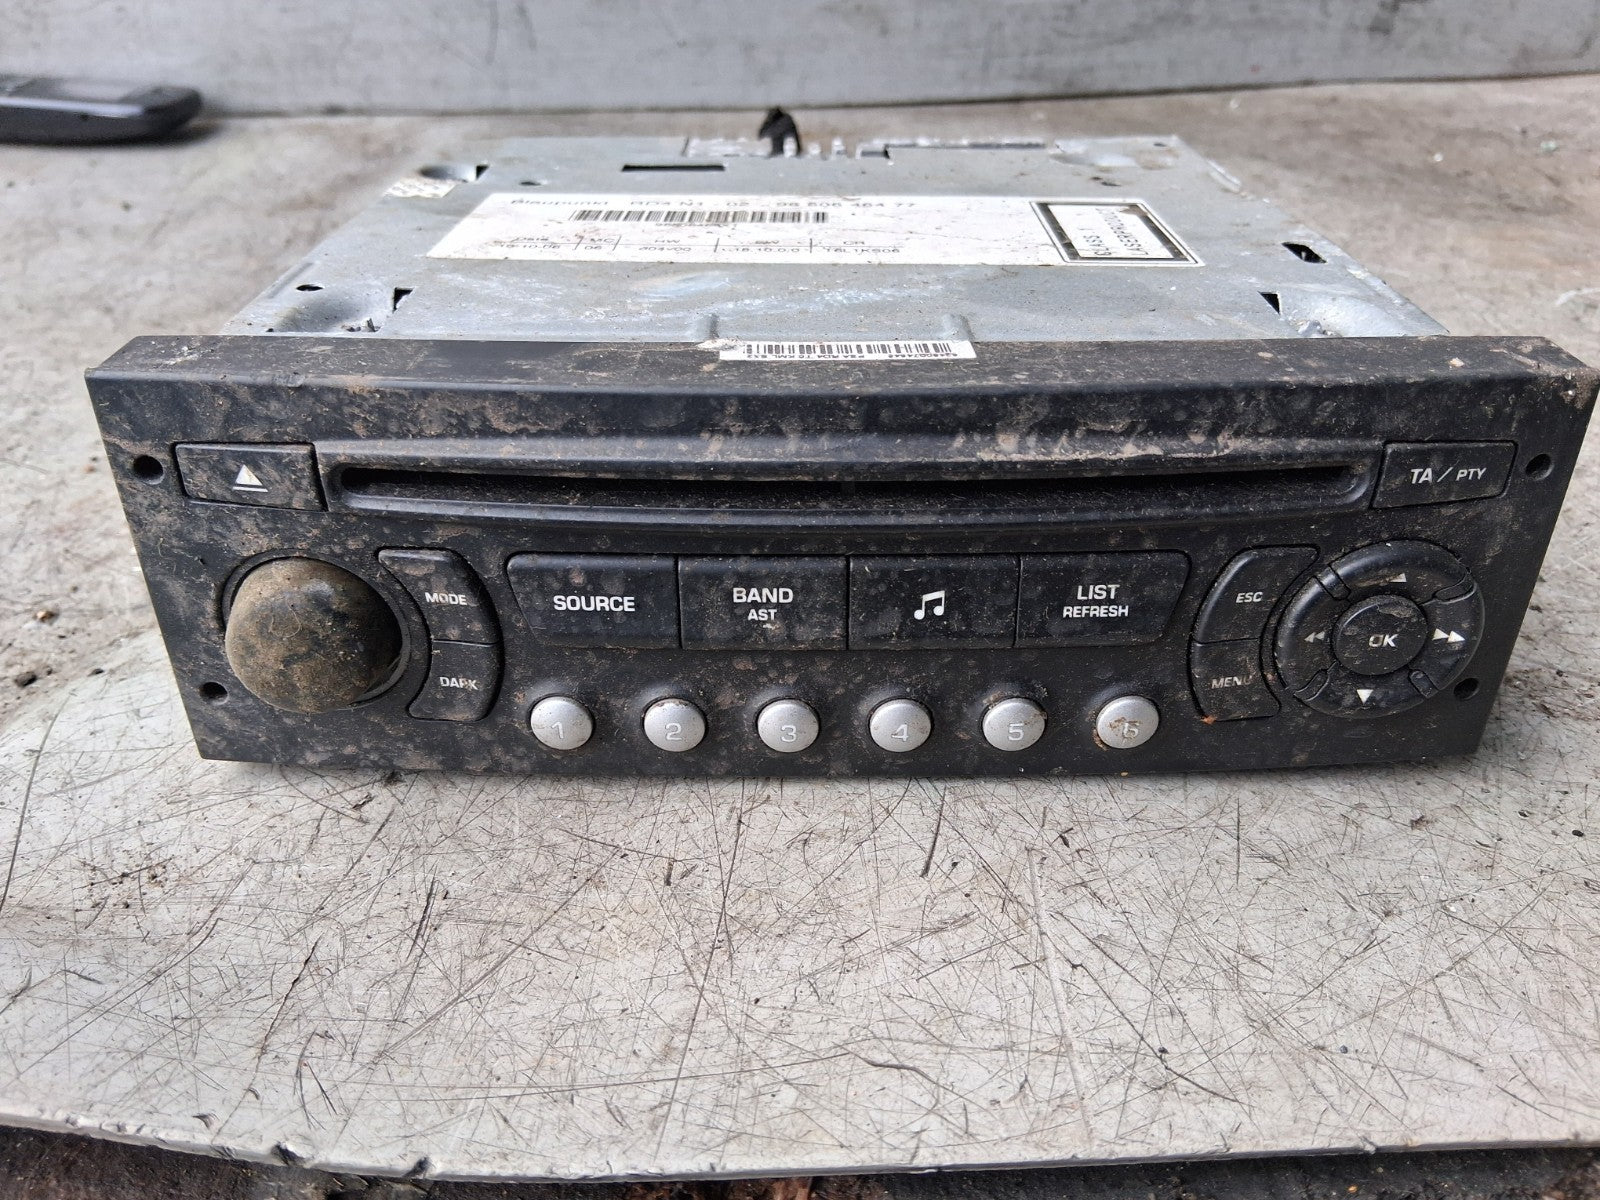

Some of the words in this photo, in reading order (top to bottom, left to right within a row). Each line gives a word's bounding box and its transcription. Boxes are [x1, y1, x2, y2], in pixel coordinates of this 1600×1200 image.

[1410, 467, 1433, 484] TA
[1456, 467, 1487, 482] PTY
[425, 591, 468, 606] MODE
[732, 587, 794, 604] BAND
[1076, 584, 1121, 600] LIST
[1235, 591, 1263, 604] ESC
[553, 595, 636, 612] SOURCE
[1062, 604, 1129, 619] REFRESH
[747, 608, 778, 622] AST
[1368, 633, 1398, 648] OK
[439, 676, 478, 691] DARK
[1211, 673, 1253, 689] MENU
[551, 722, 565, 740] 1
[664, 722, 683, 742] 2
[780, 724, 797, 742] 3
[891, 724, 909, 742] 4
[1008, 723, 1025, 742] 5
[1122, 721, 1140, 741] 6
